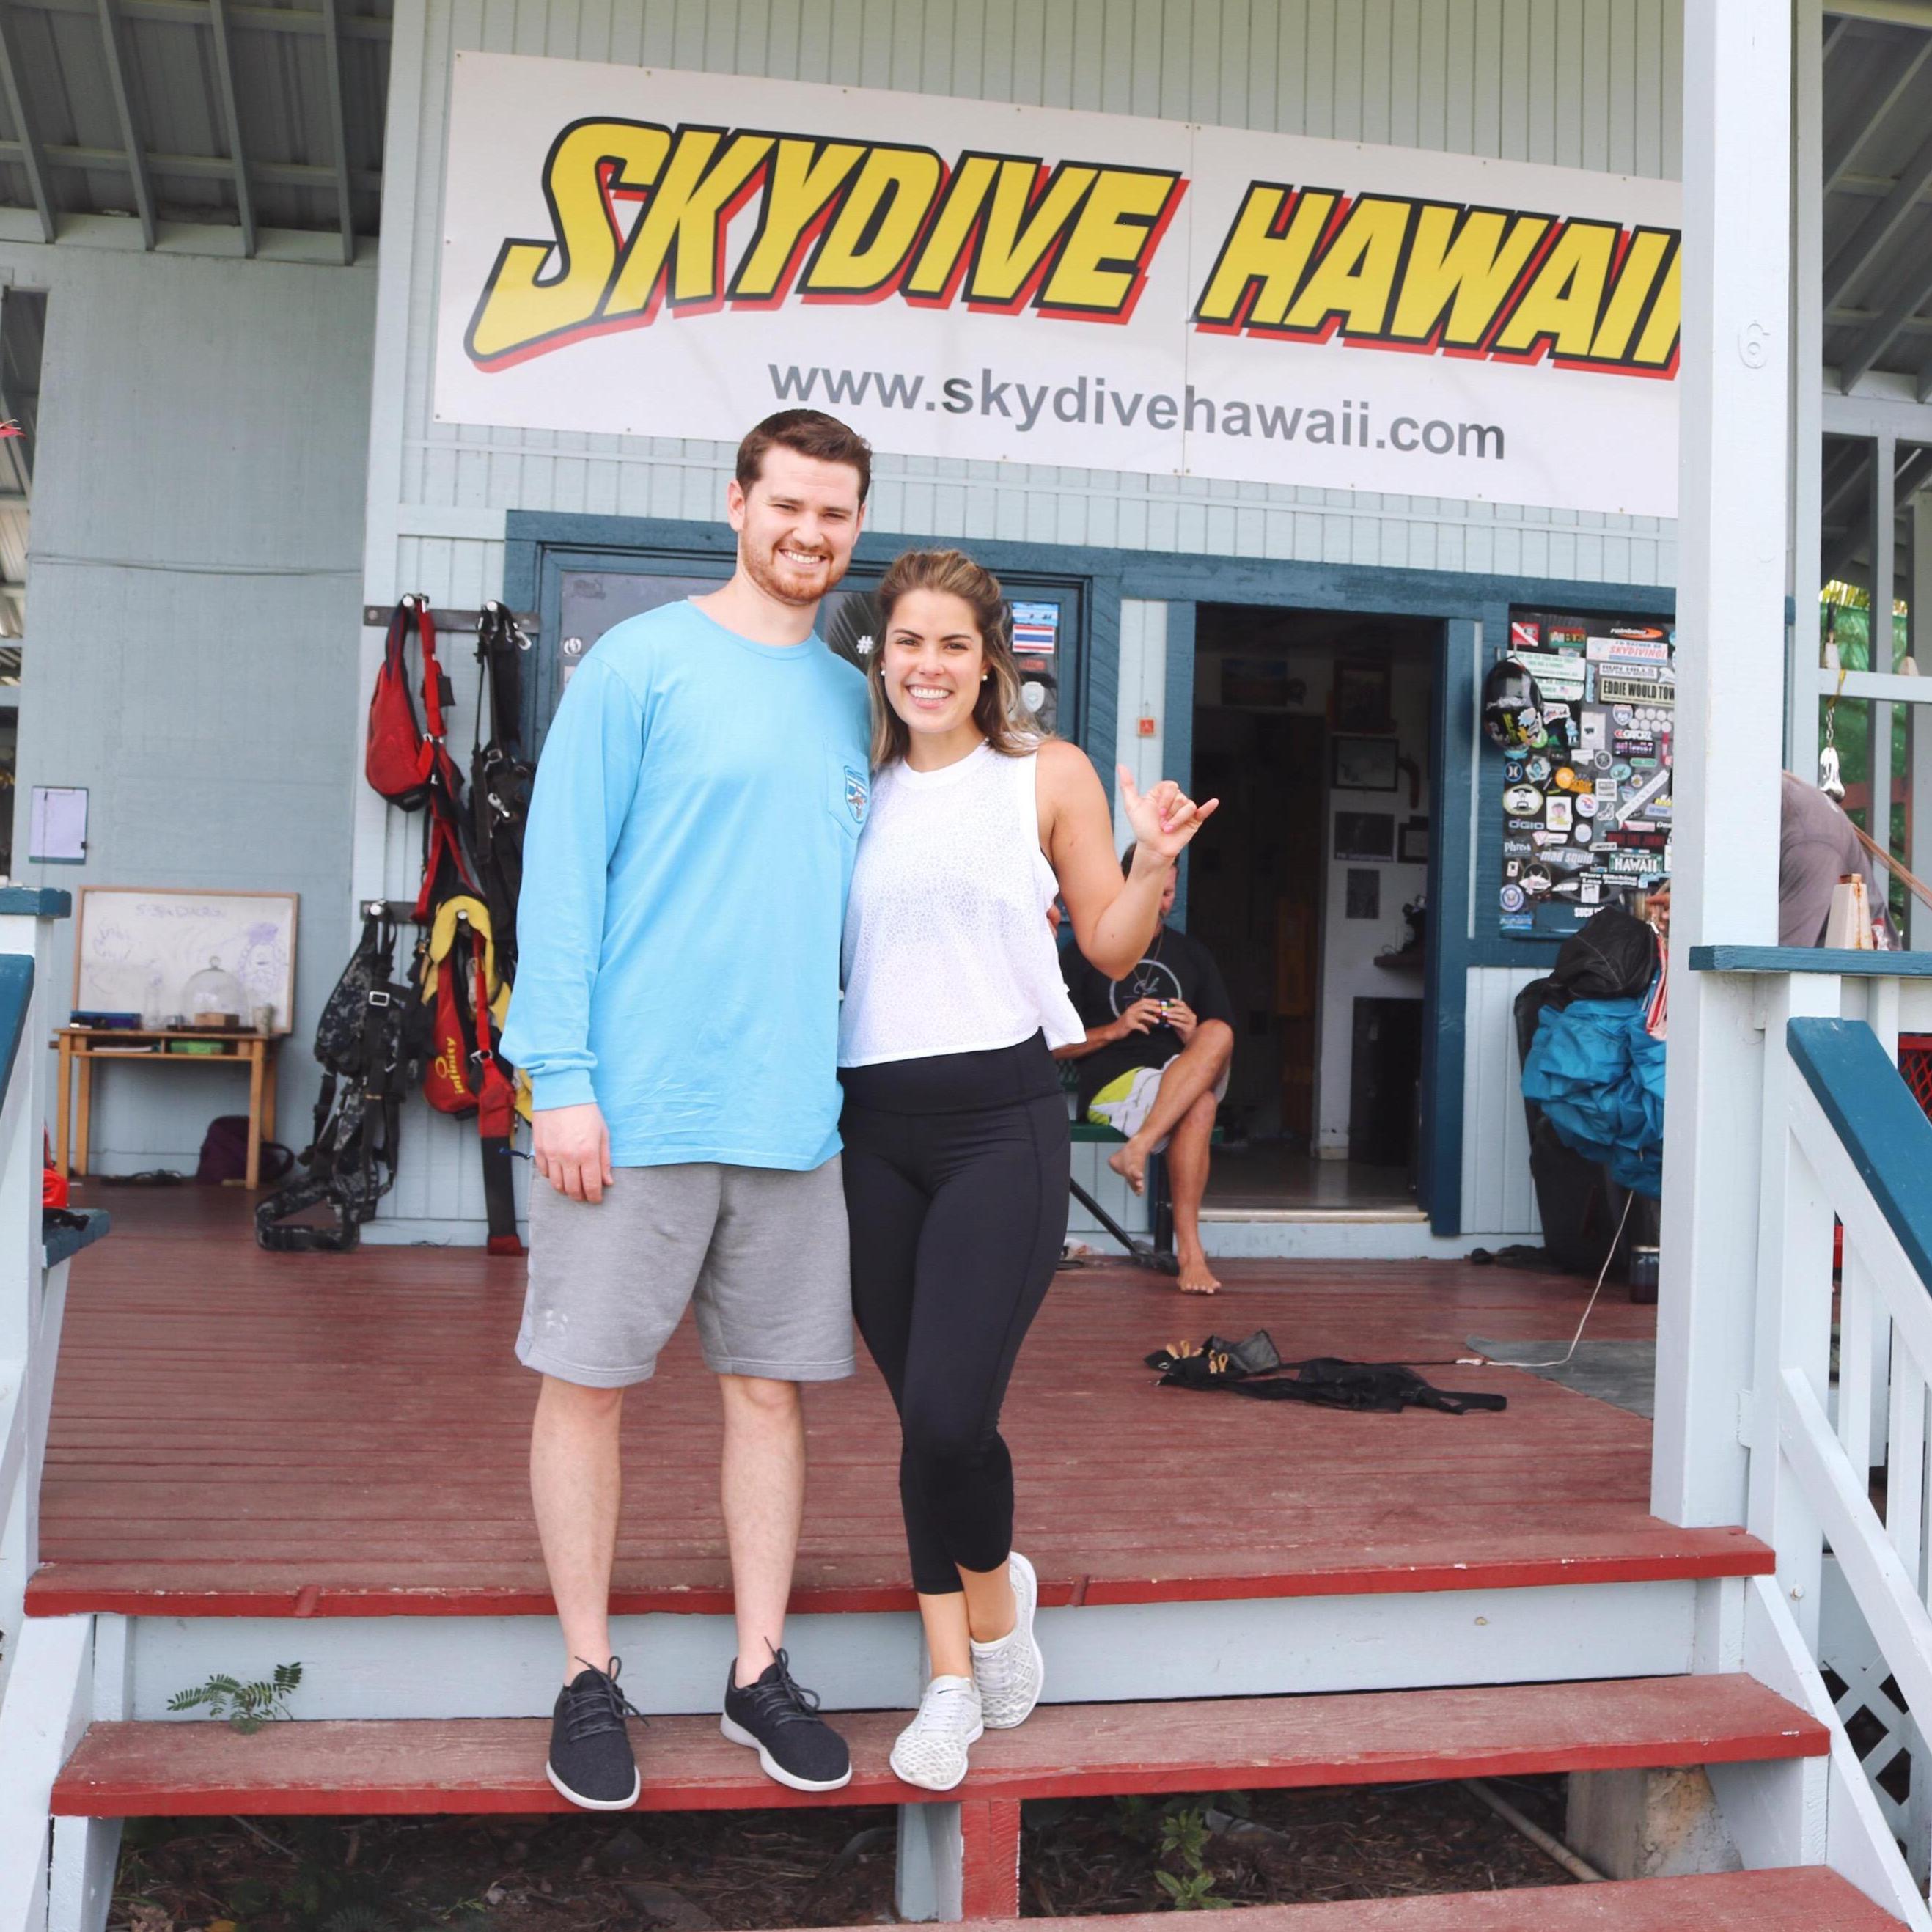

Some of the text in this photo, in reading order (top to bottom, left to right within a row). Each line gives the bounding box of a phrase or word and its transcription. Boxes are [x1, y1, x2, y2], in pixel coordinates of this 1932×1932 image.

[463, 116, 1681, 381] SKYDIVE HAWAII
[768, 364, 1505, 460] www.skydivehawaii.com
[1604, 680, 1626, 695] EDDIE
[1628, 683, 1656, 699] WOULD
[1540, 851, 1594, 864] mad squid
[1615, 857, 1657, 872] HAWAII
[446, 1036, 466, 1095] infinity
